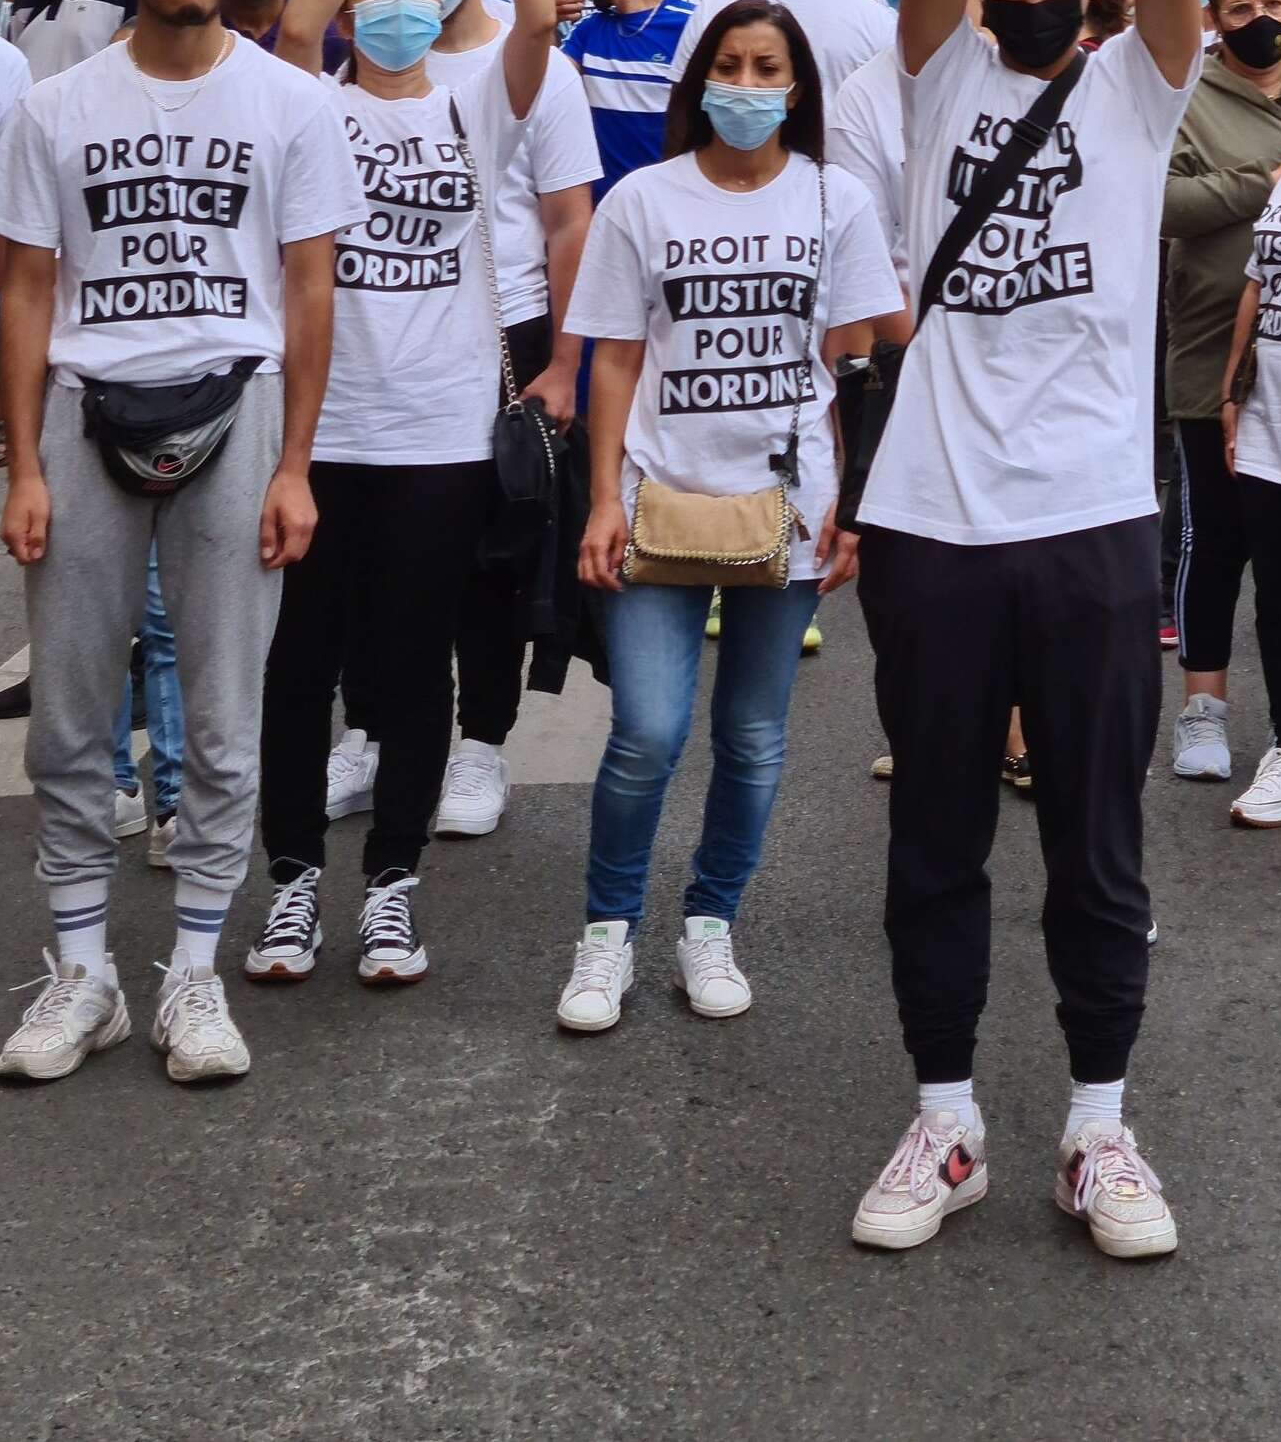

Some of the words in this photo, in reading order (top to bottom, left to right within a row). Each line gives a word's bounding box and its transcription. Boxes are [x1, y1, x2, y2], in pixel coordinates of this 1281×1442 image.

[85, 133, 195, 176] DROIT
[205, 137, 254, 174] DE
[101, 181, 232, 223] JUSTICE
[345, 210, 442, 247] OUR
[121, 231, 209, 268] POUR
[665, 235, 770, 269] DROIT
[785, 235, 820, 268] DE
[84, 277, 244, 319] NORDINE
[679, 277, 808, 315] JUSTICE
[942, 250, 1089, 308] ORDINE
[695, 325, 783, 359] POUR
[661, 365, 815, 409] NORDINE
